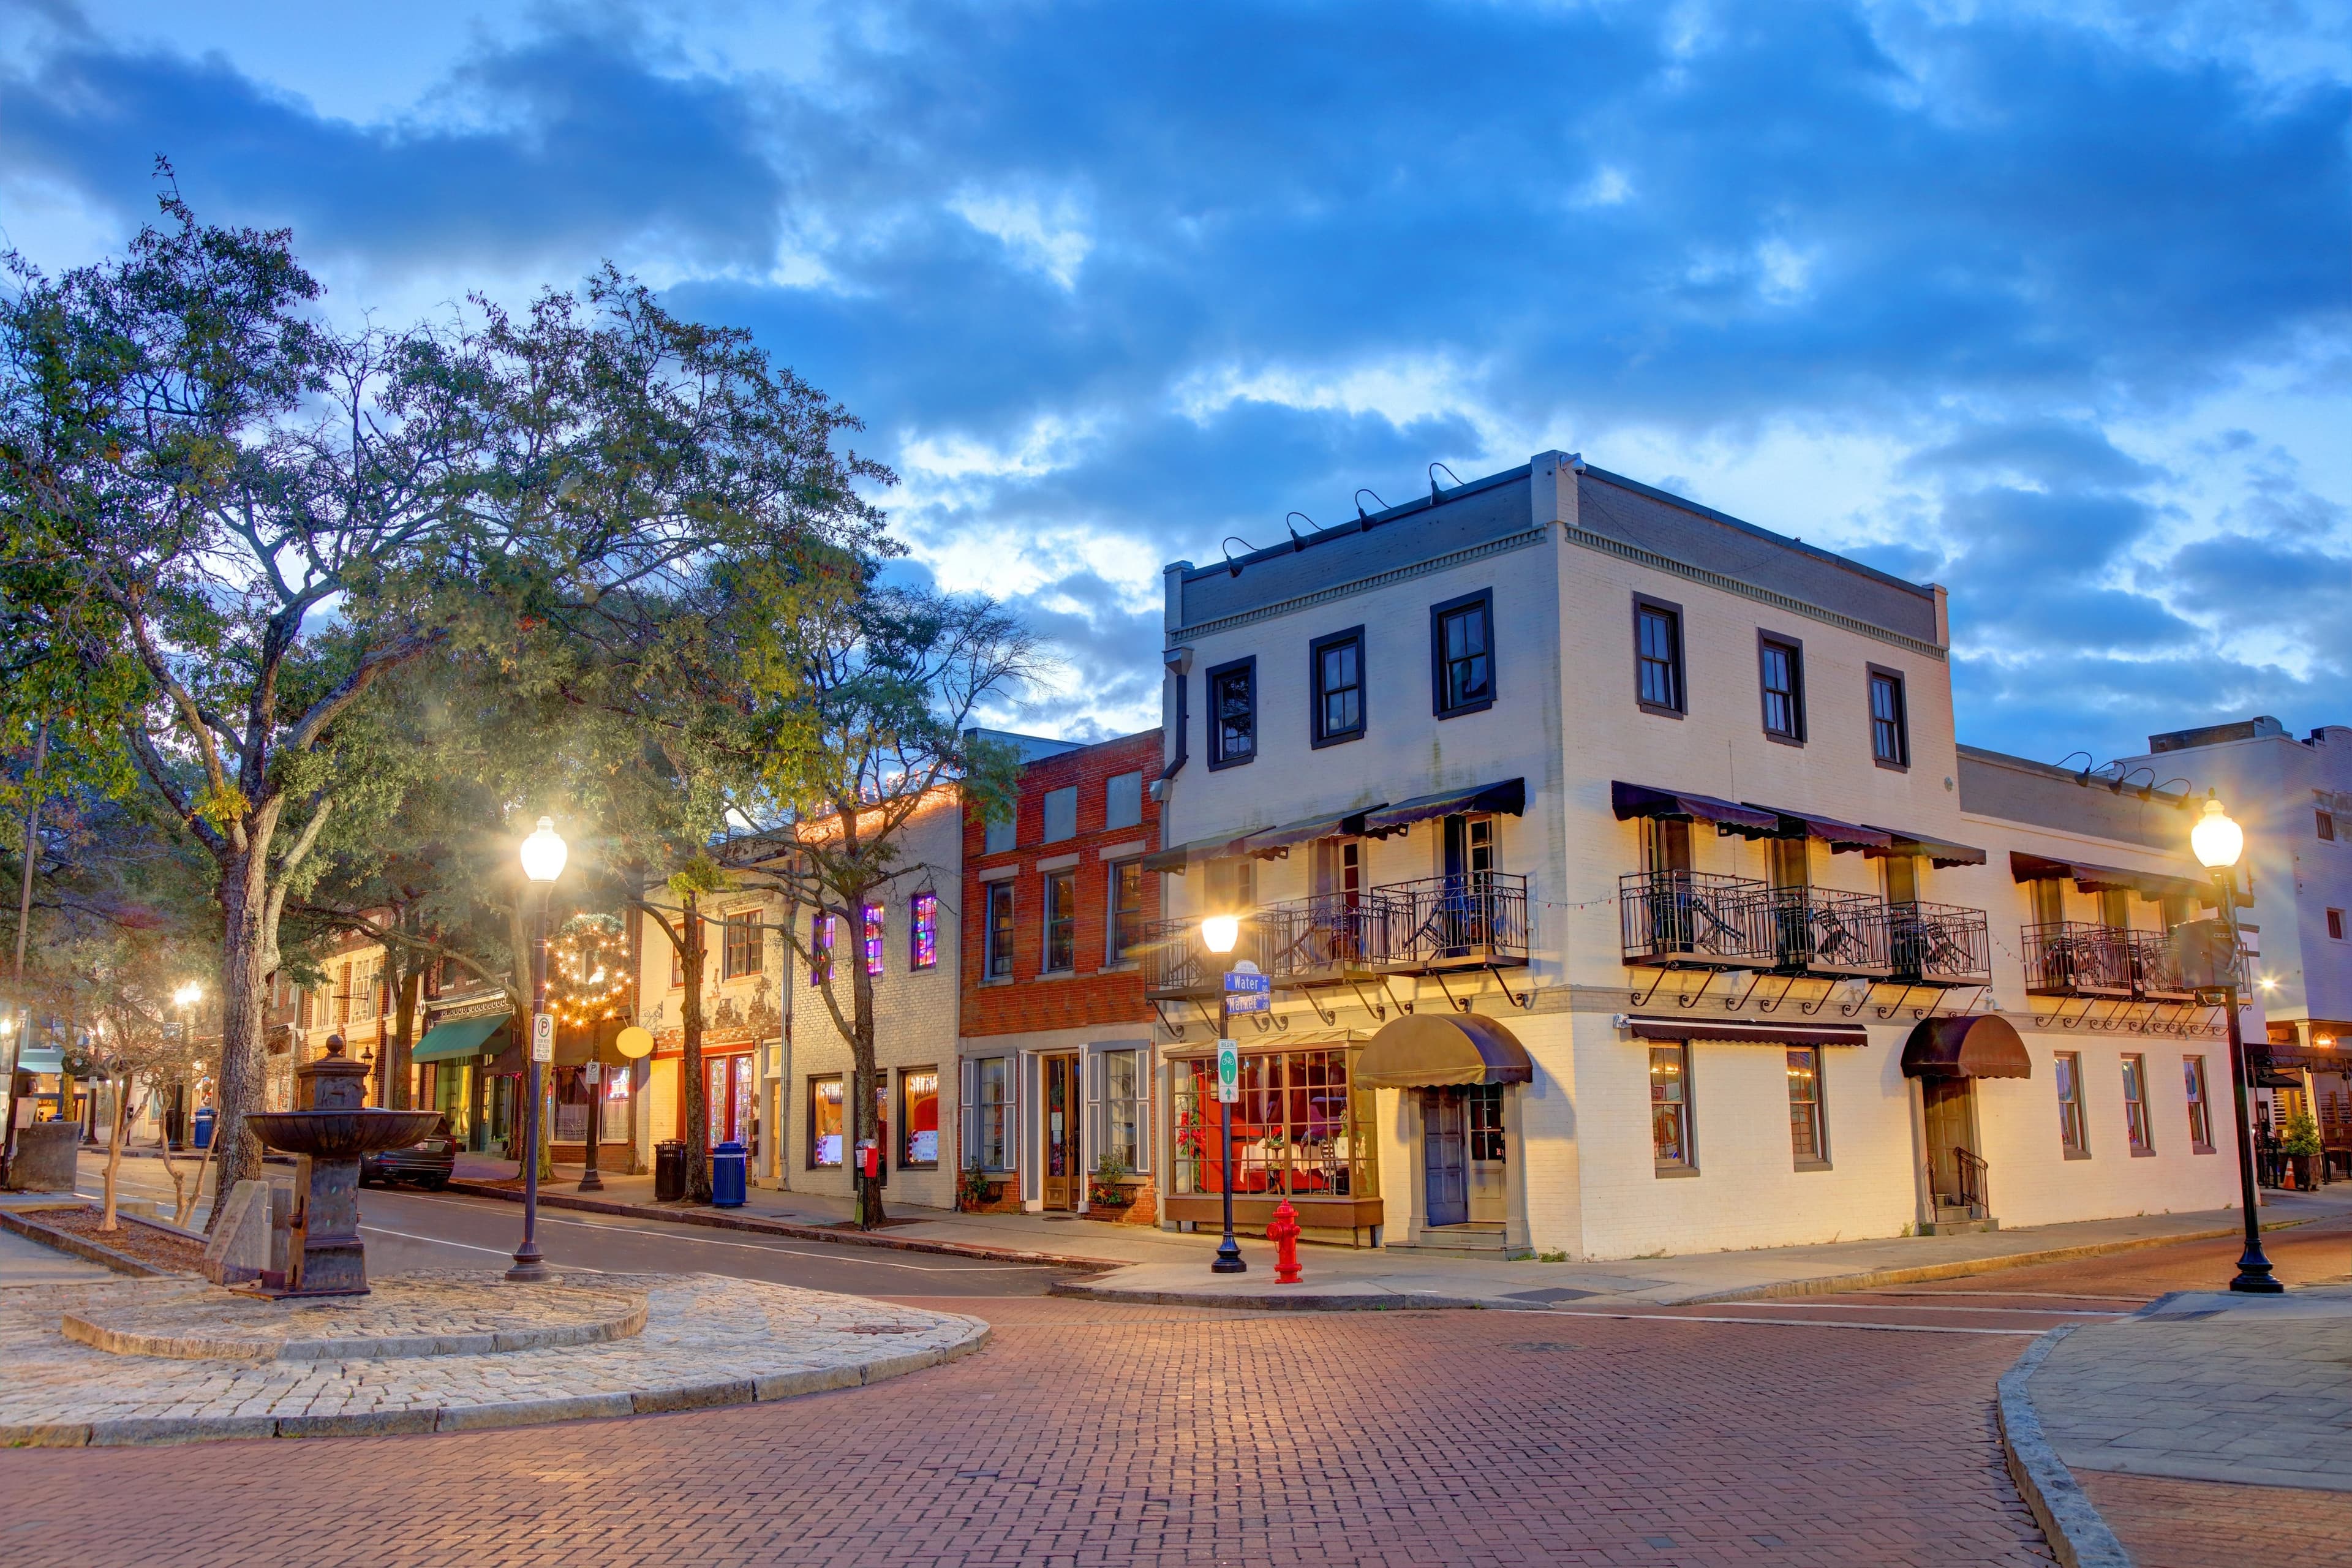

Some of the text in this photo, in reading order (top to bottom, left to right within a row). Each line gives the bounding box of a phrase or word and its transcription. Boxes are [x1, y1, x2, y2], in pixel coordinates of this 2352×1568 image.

[1234, 975, 1258, 990] Water
[1229, 997, 1257, 1011] Market
[541, 1020, 548, 1033] P
[1227, 1070, 1230, 1082] 1
